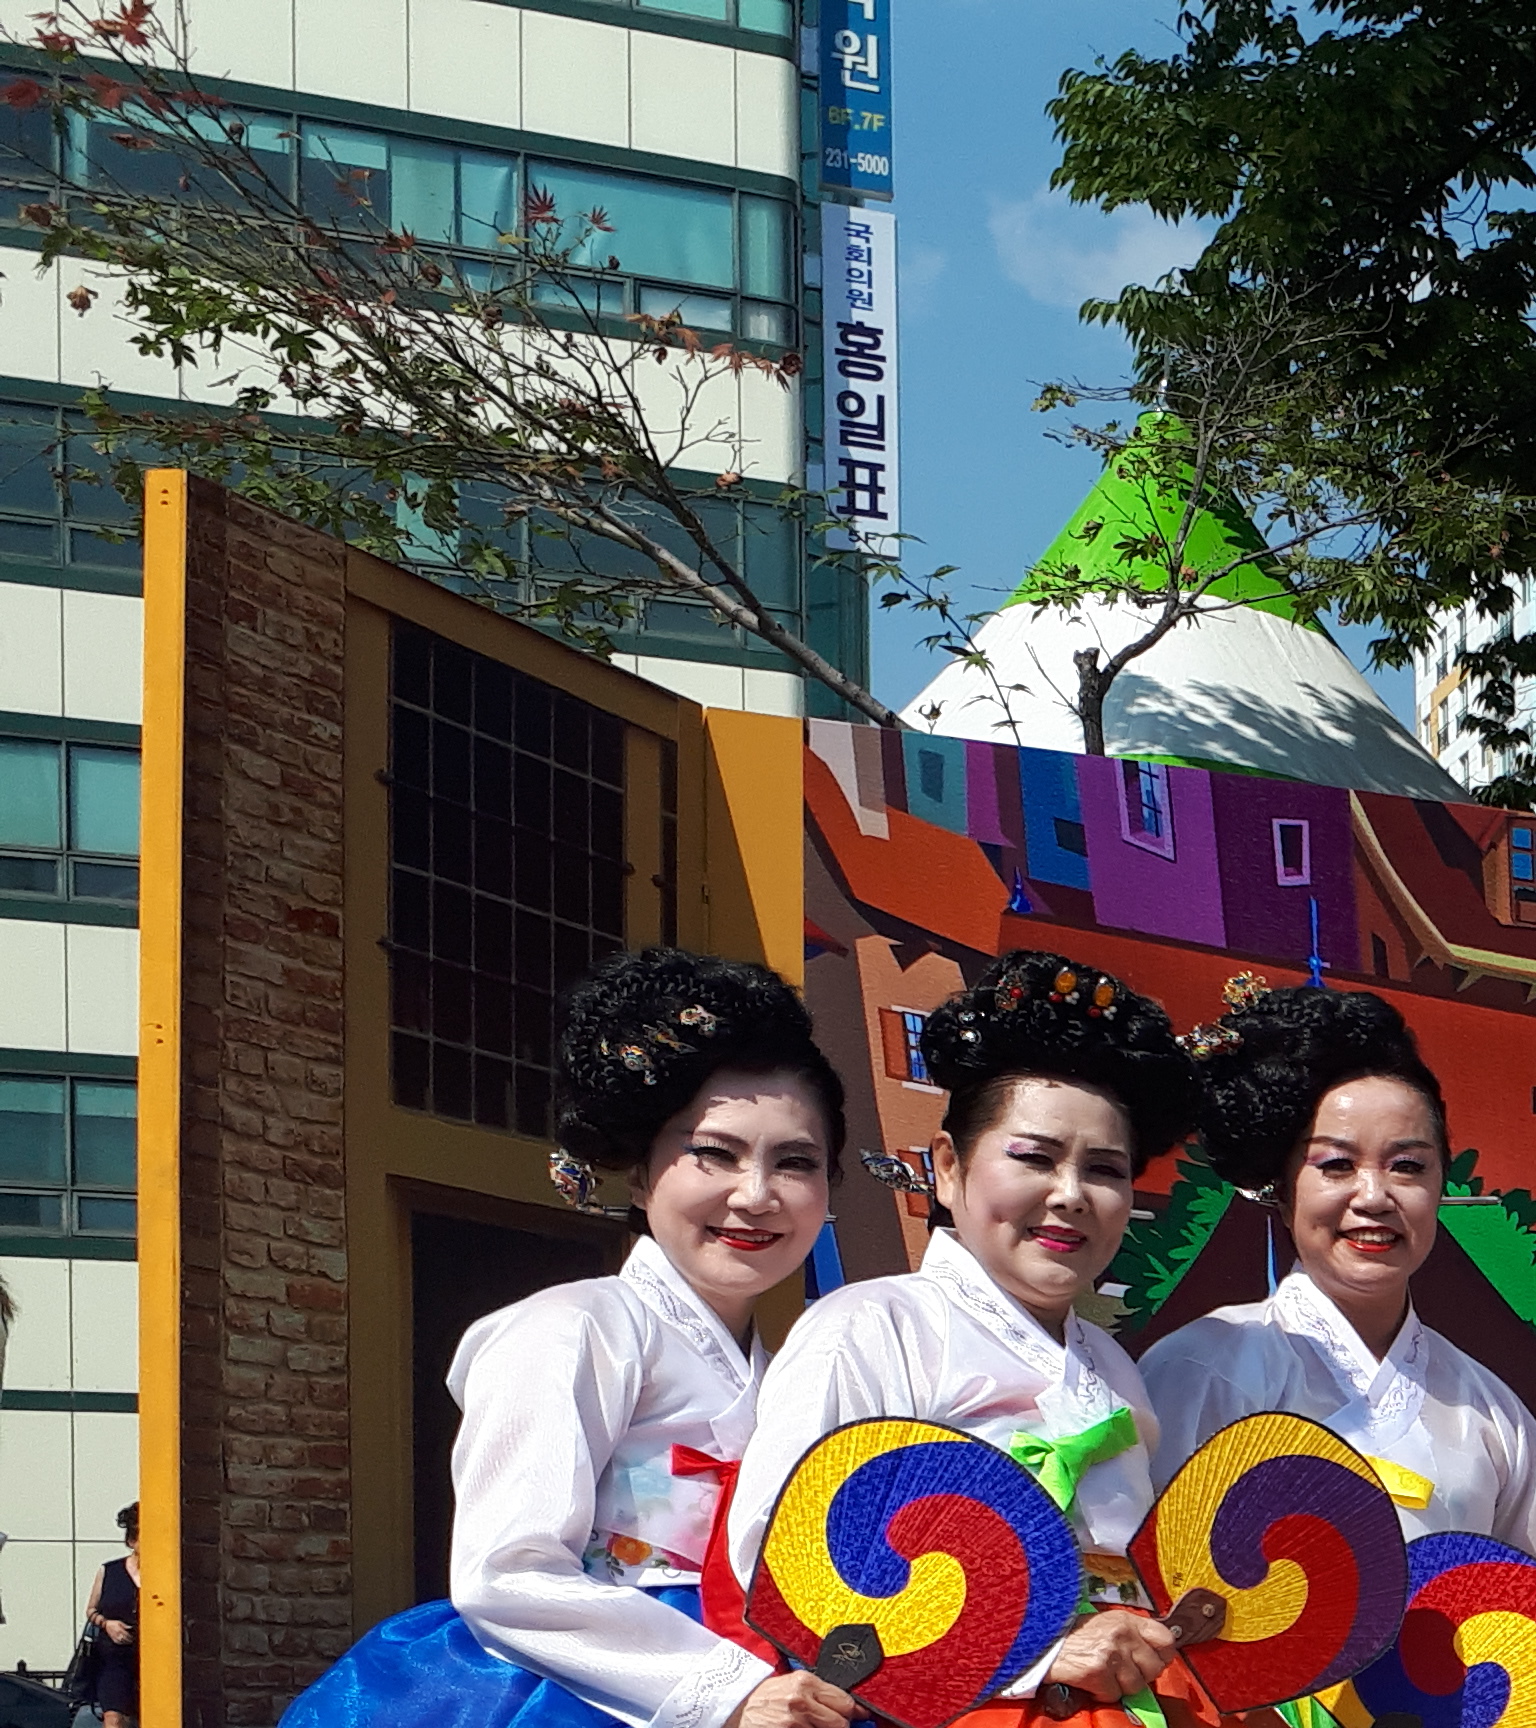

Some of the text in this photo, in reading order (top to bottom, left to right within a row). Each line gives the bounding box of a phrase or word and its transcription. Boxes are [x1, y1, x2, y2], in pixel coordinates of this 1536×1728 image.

[825, 148, 890, 176] 231-5000
[843, 220, 874, 312] 국회의원
[834, 320, 888, 521] 홍일표
